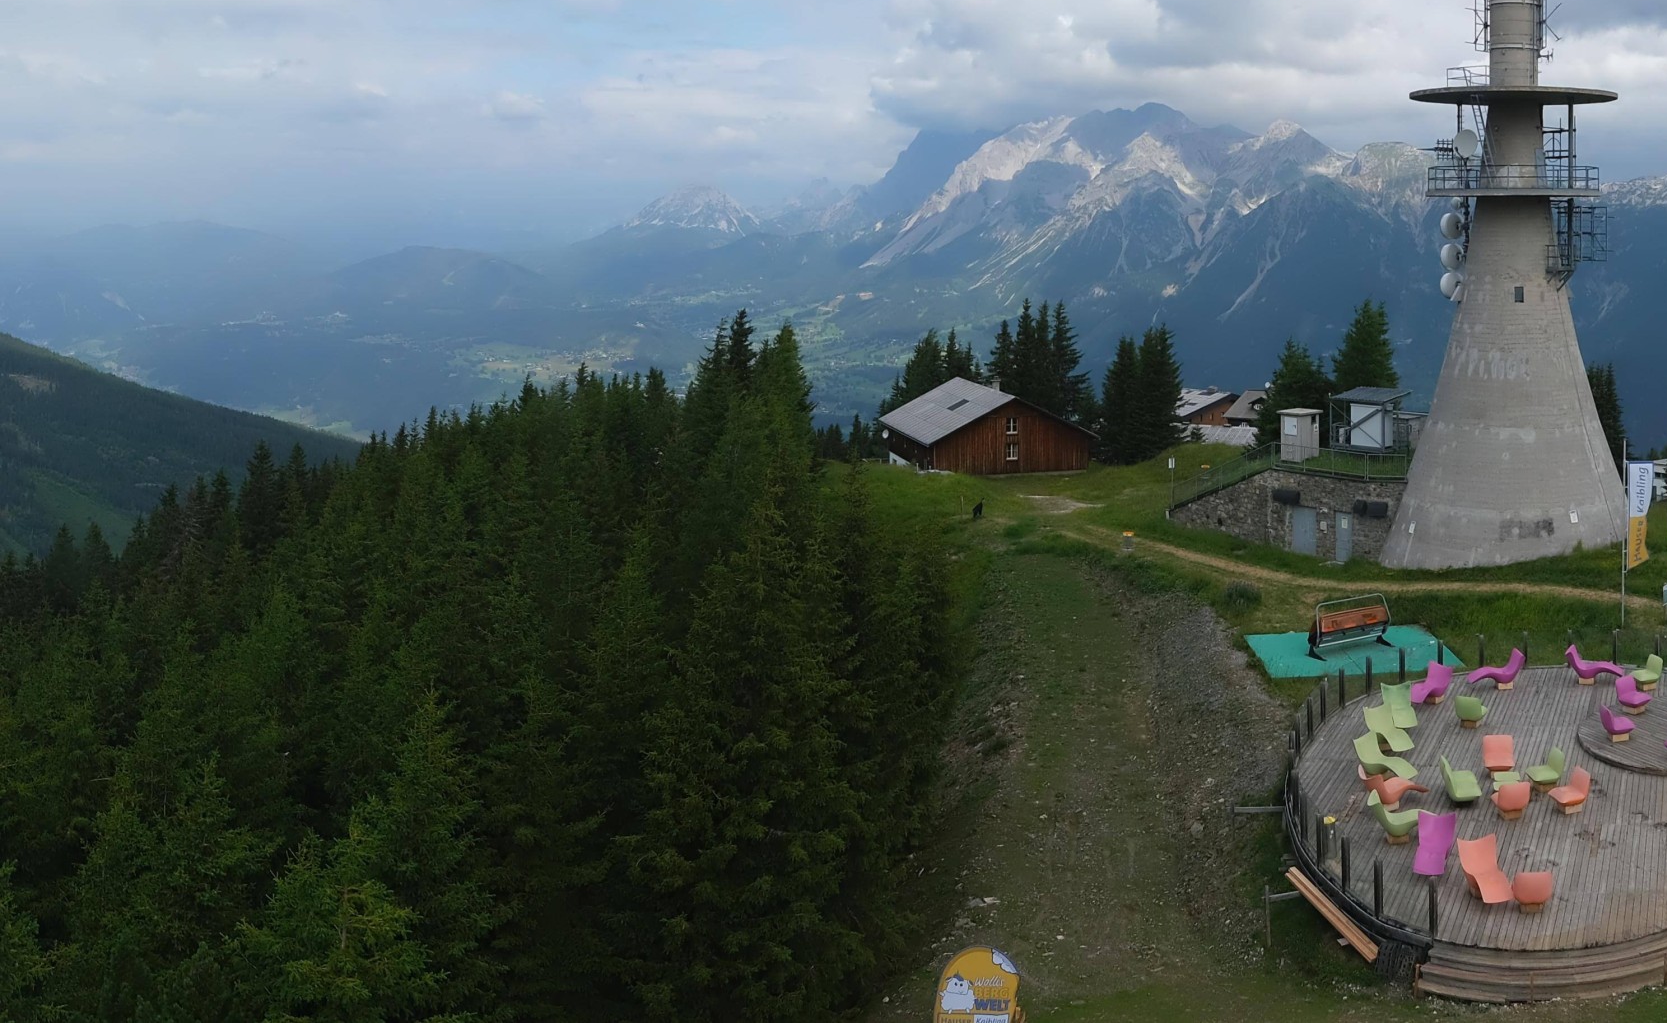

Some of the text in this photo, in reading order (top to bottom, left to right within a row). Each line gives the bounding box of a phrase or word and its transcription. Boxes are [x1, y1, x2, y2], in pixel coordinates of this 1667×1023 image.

[1636, 467, 1649, 513] Kaibling
[975, 976, 1003, 986] Wollis
[974, 987, 1009, 998] BERG
[974, 998, 1010, 1011] WELT
